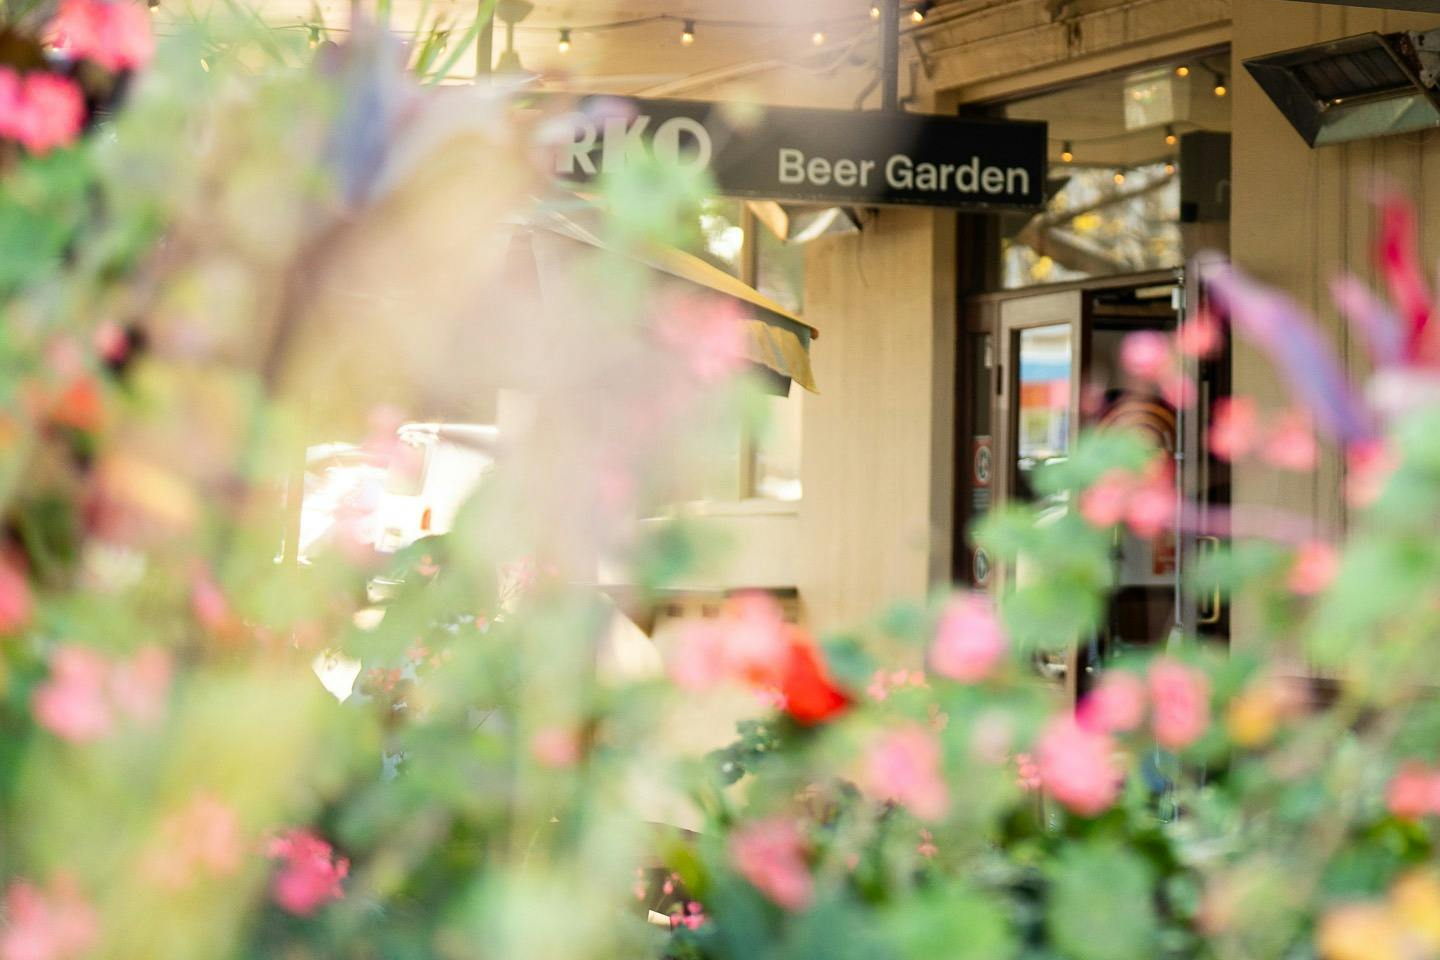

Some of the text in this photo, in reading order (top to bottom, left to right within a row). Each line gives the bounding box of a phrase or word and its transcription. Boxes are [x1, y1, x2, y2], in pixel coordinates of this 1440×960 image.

[536, 110, 1031, 196] RKO Beer Garden
